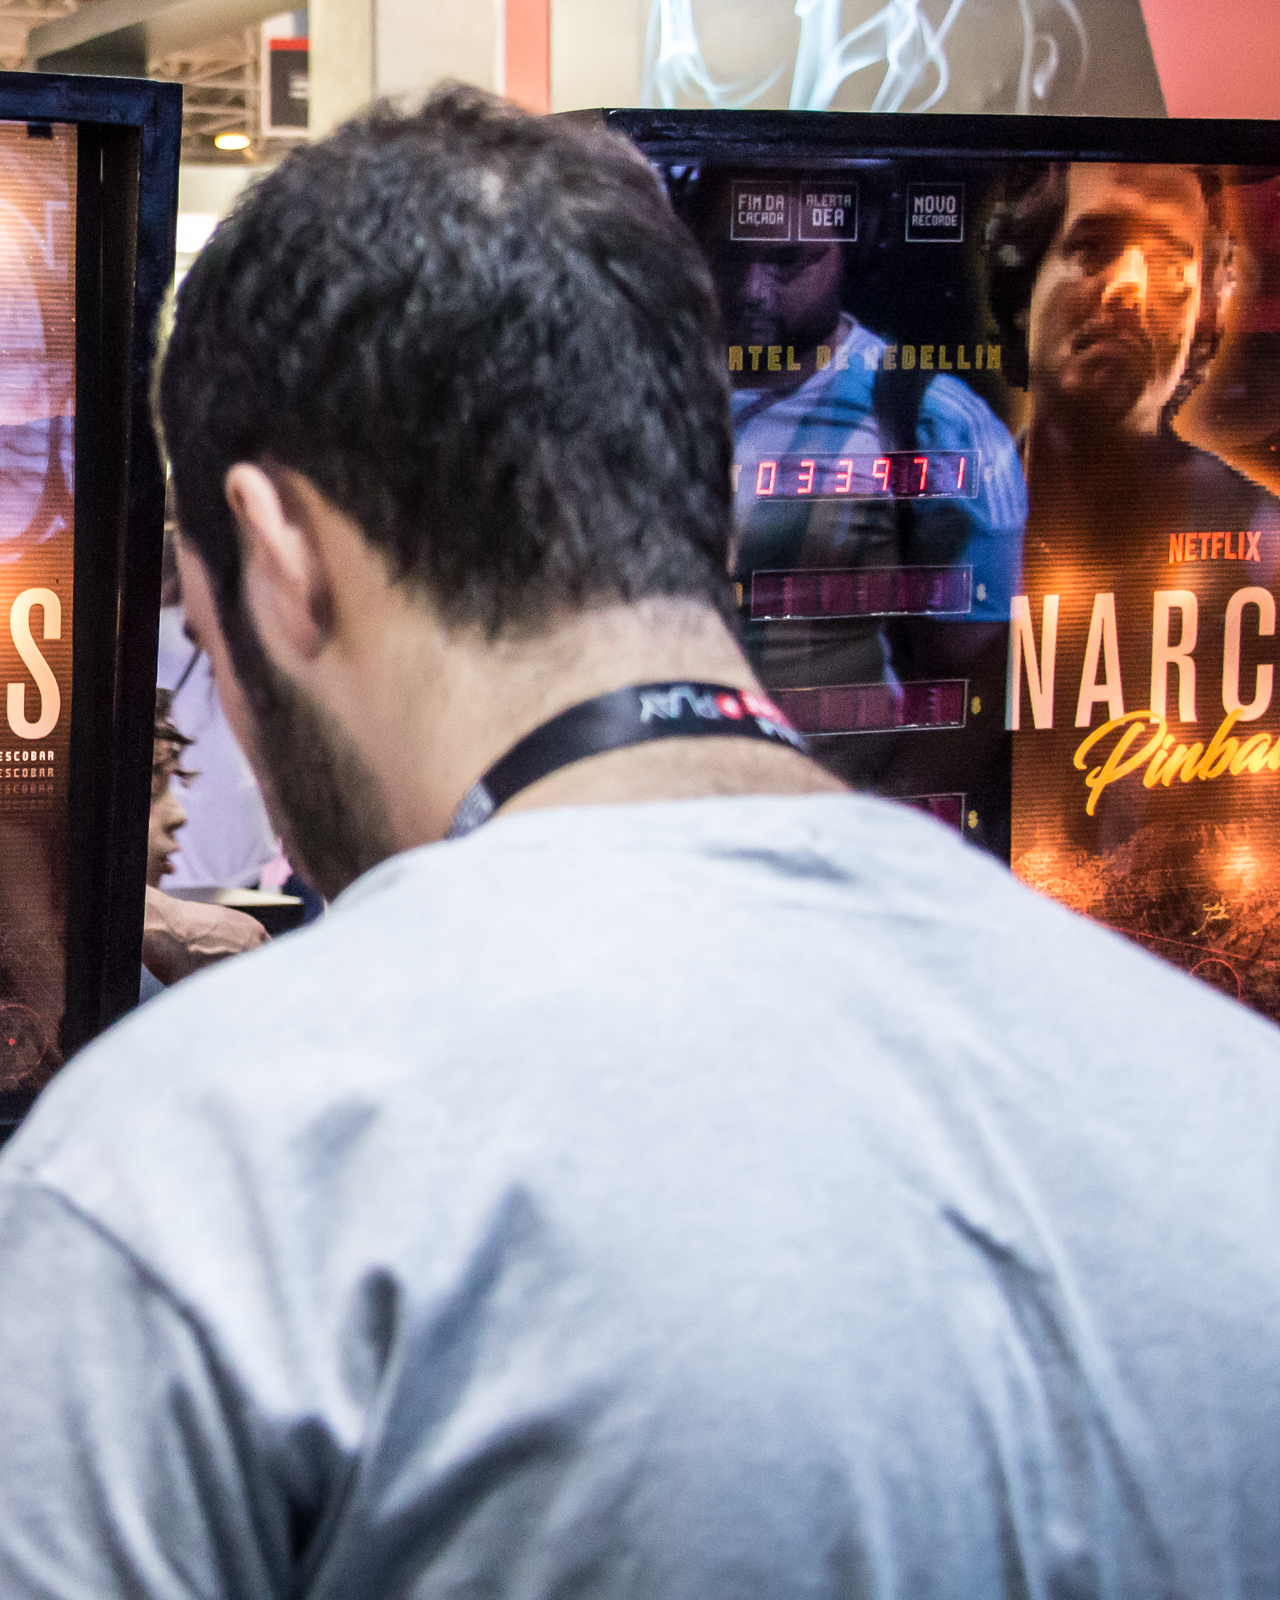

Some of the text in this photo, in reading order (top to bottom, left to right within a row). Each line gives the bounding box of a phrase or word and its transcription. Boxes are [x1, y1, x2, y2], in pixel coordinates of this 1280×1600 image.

[738, 193, 785, 211] FIM DA
[806, 194, 852, 207] ALERTA
[914, 195, 956, 214] NOVO
[812, 208, 844, 226] DEA
[911, 214, 958, 227] RECORDE
[728, 344, 1002, 371] RTEL DE MEDELLIN
[755, 456, 966, 496] 033971
[1168, 530, 1262, 565] NETFLIX
[1005, 586, 1277, 731] NARC
